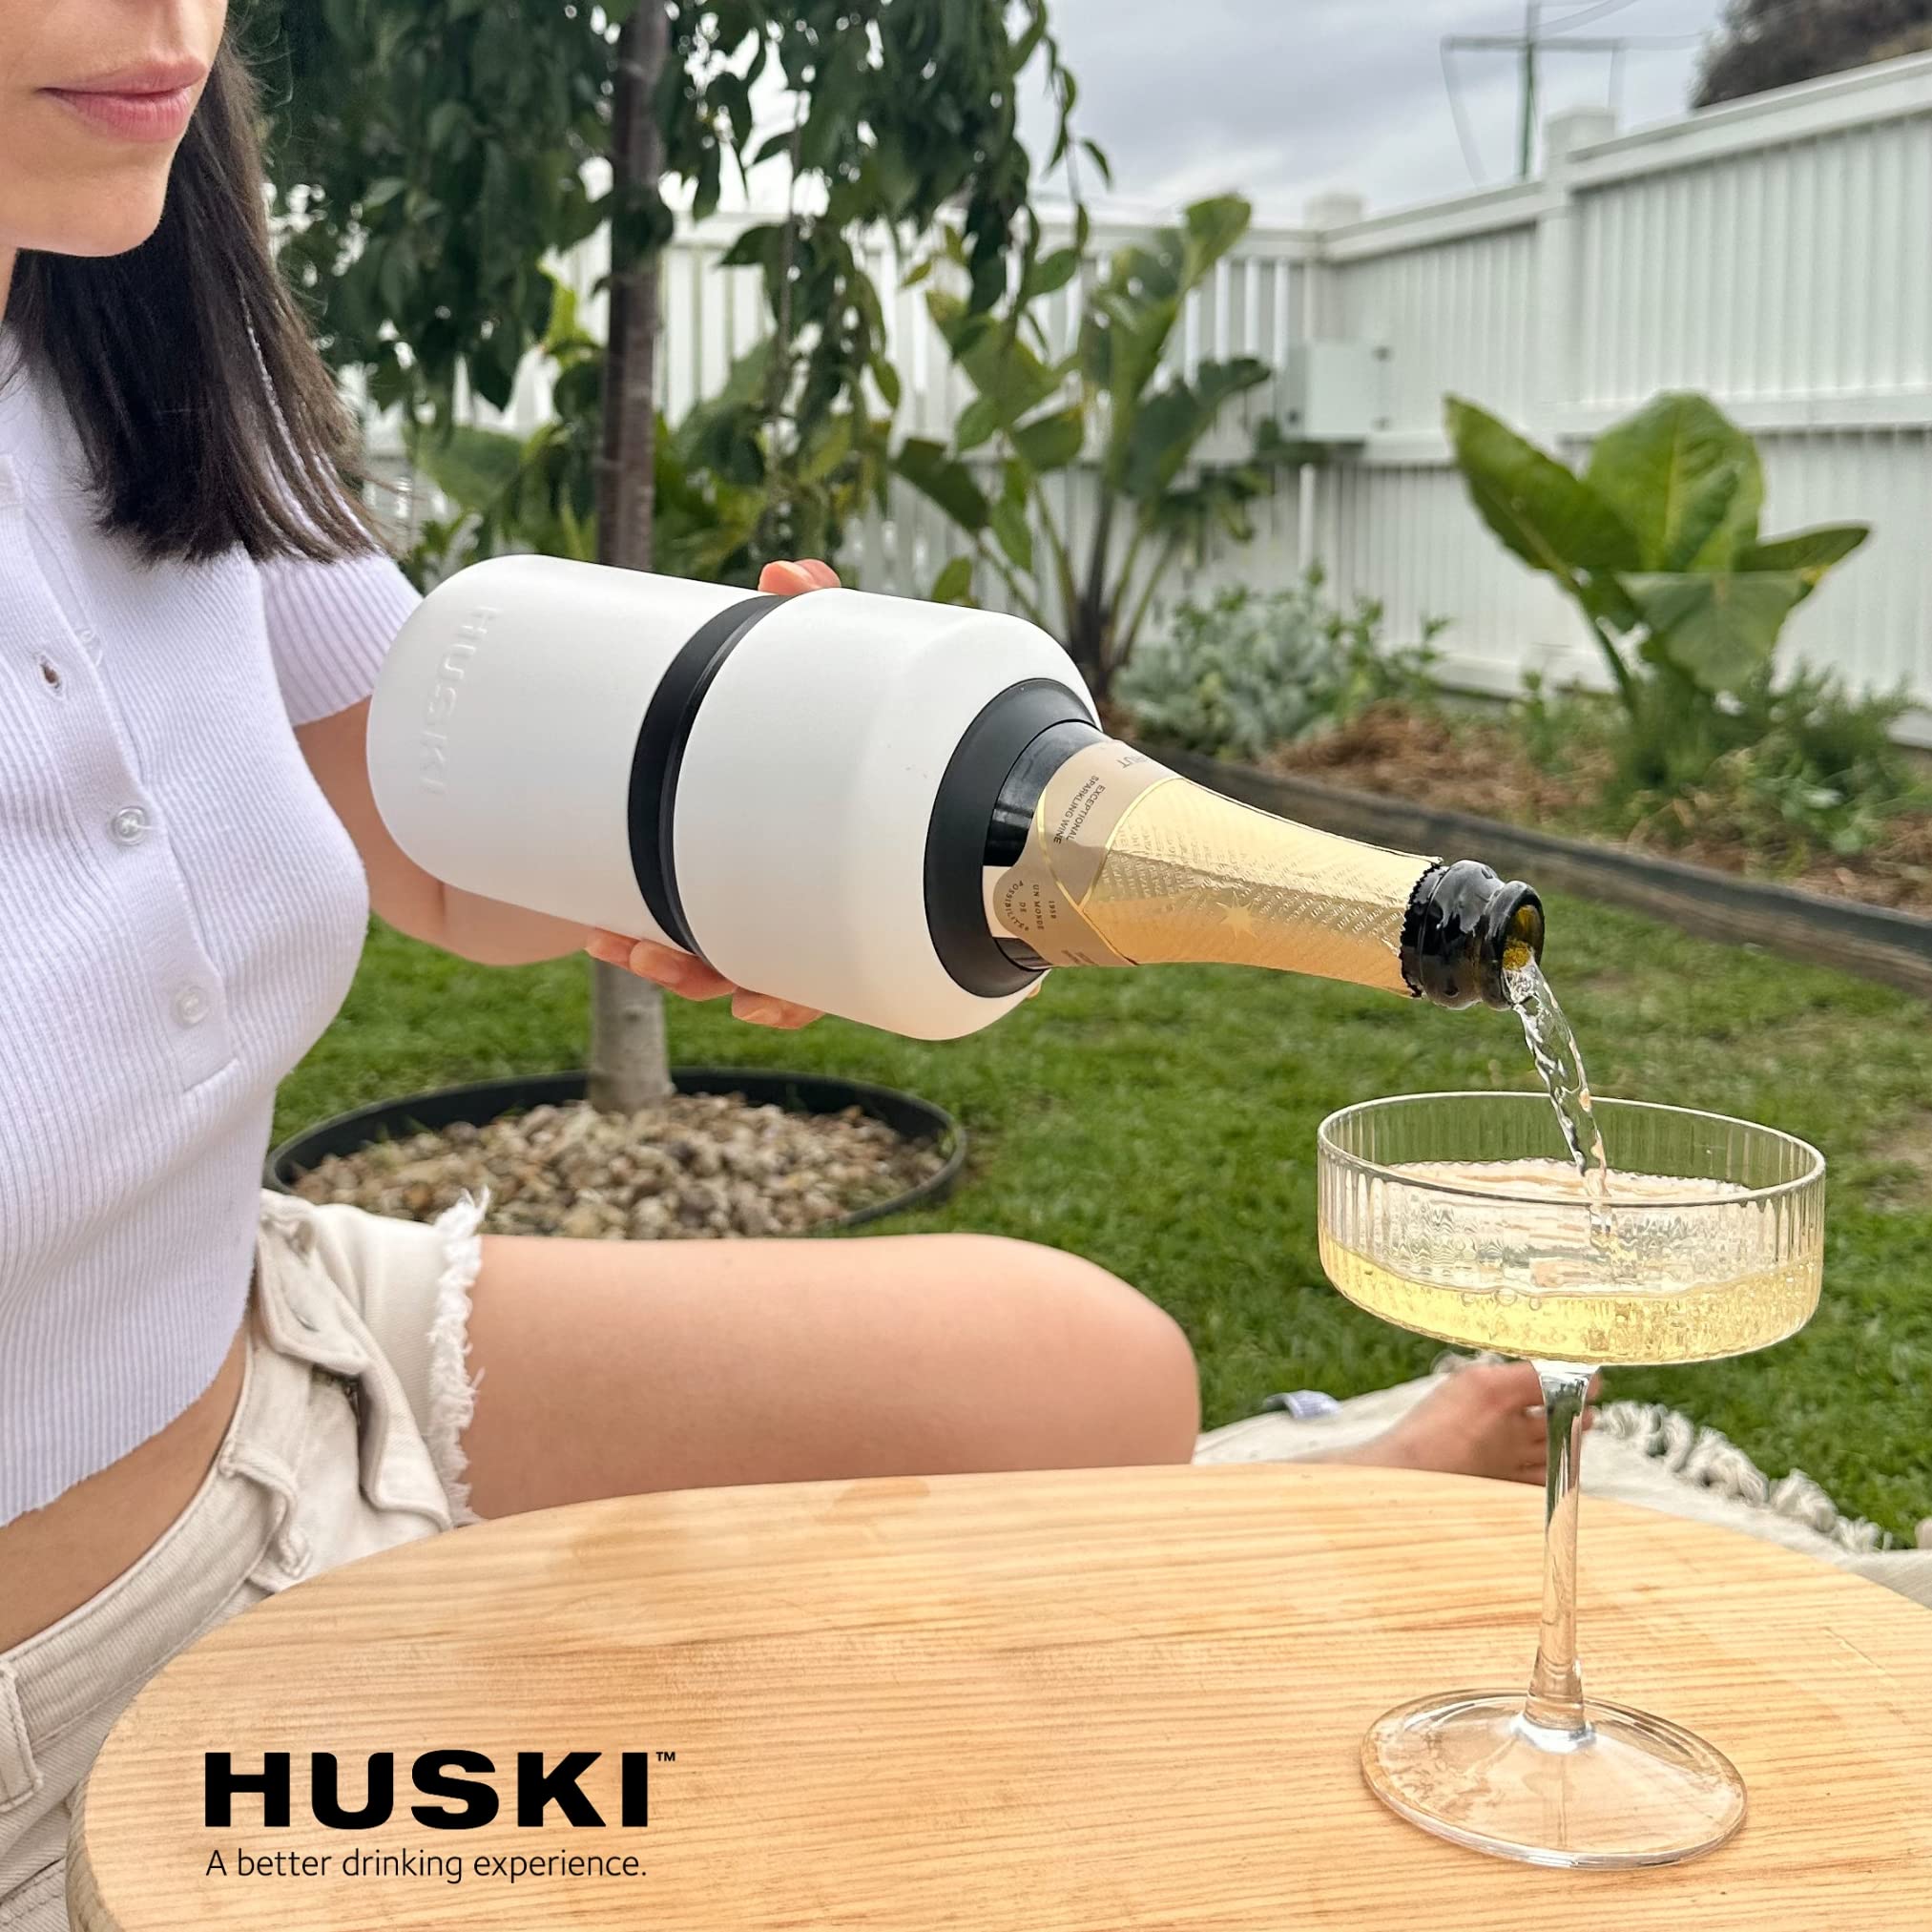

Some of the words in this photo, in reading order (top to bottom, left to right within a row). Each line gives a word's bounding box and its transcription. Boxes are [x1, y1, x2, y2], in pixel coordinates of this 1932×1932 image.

[418, 605, 502, 794] HUSKI
[1065, 775, 1099, 819] SPARKLING
[1066, 784, 1106, 841] EXCEPTIONAL
[1053, 819, 1070, 844] WINE
